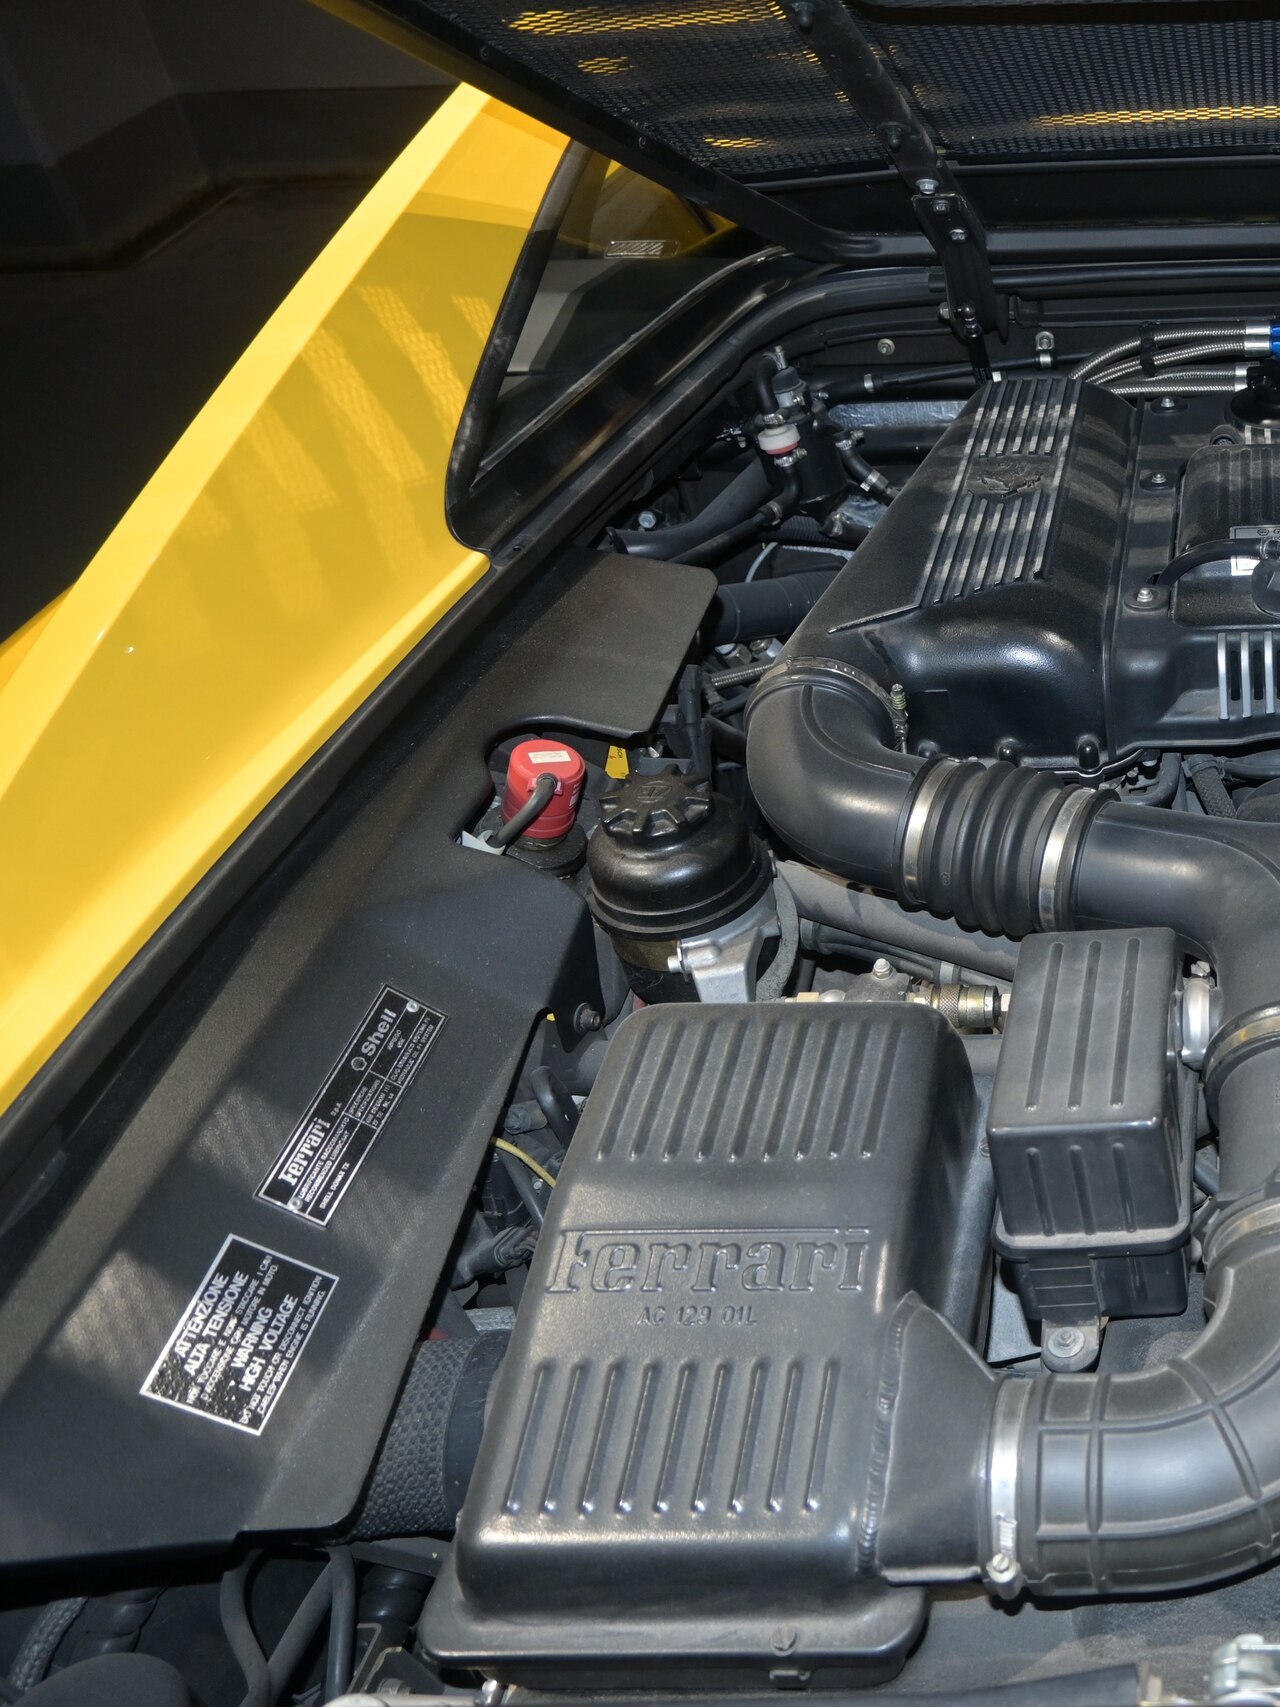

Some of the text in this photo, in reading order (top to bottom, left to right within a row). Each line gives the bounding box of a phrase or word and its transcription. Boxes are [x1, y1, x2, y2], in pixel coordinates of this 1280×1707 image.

[358, 1007, 398, 1057] Shell
[276, 1115, 332, 1186] Ferrari
[296, 1115, 350, 1199] LUBRIFICANTE RACCOMANDATO
[303, 1129, 351, 1203] RECOMMENDED LUBRICANT
[318, 1189, 334, 1209] SHELL
[547, 1228, 871, 1294] Ferrari
[170, 1272, 230, 1358] ATTENZIONE
[180, 1270, 250, 1376] ALTA TENSIONE
[196, 1347, 222, 1384] TOCCARE
[234, 1277, 260, 1315] STACCARE
[229, 1305, 274, 1370] WARNING
[237, 1293, 299, 1392] HIGH VOLTAGE
[239, 1295, 262, 1326] MOTORE
[256, 1285, 267, 1295] IN
[637, 1306, 664, 1326] AC
[239, 1409, 253, 1424] DO
[256, 1364, 276, 1392] TOUCH
[270, 1351, 283, 1365] OR
[277, 1305, 306, 1351] DISCONNECT
[301, 1274, 322, 1305] IGNITION
[256, 1382, 278, 1414] CABLES
[272, 1358, 290, 1383] WHEN
[284, 1331, 304, 1359] ENGINE
[299, 1321, 309, 1330] IS
